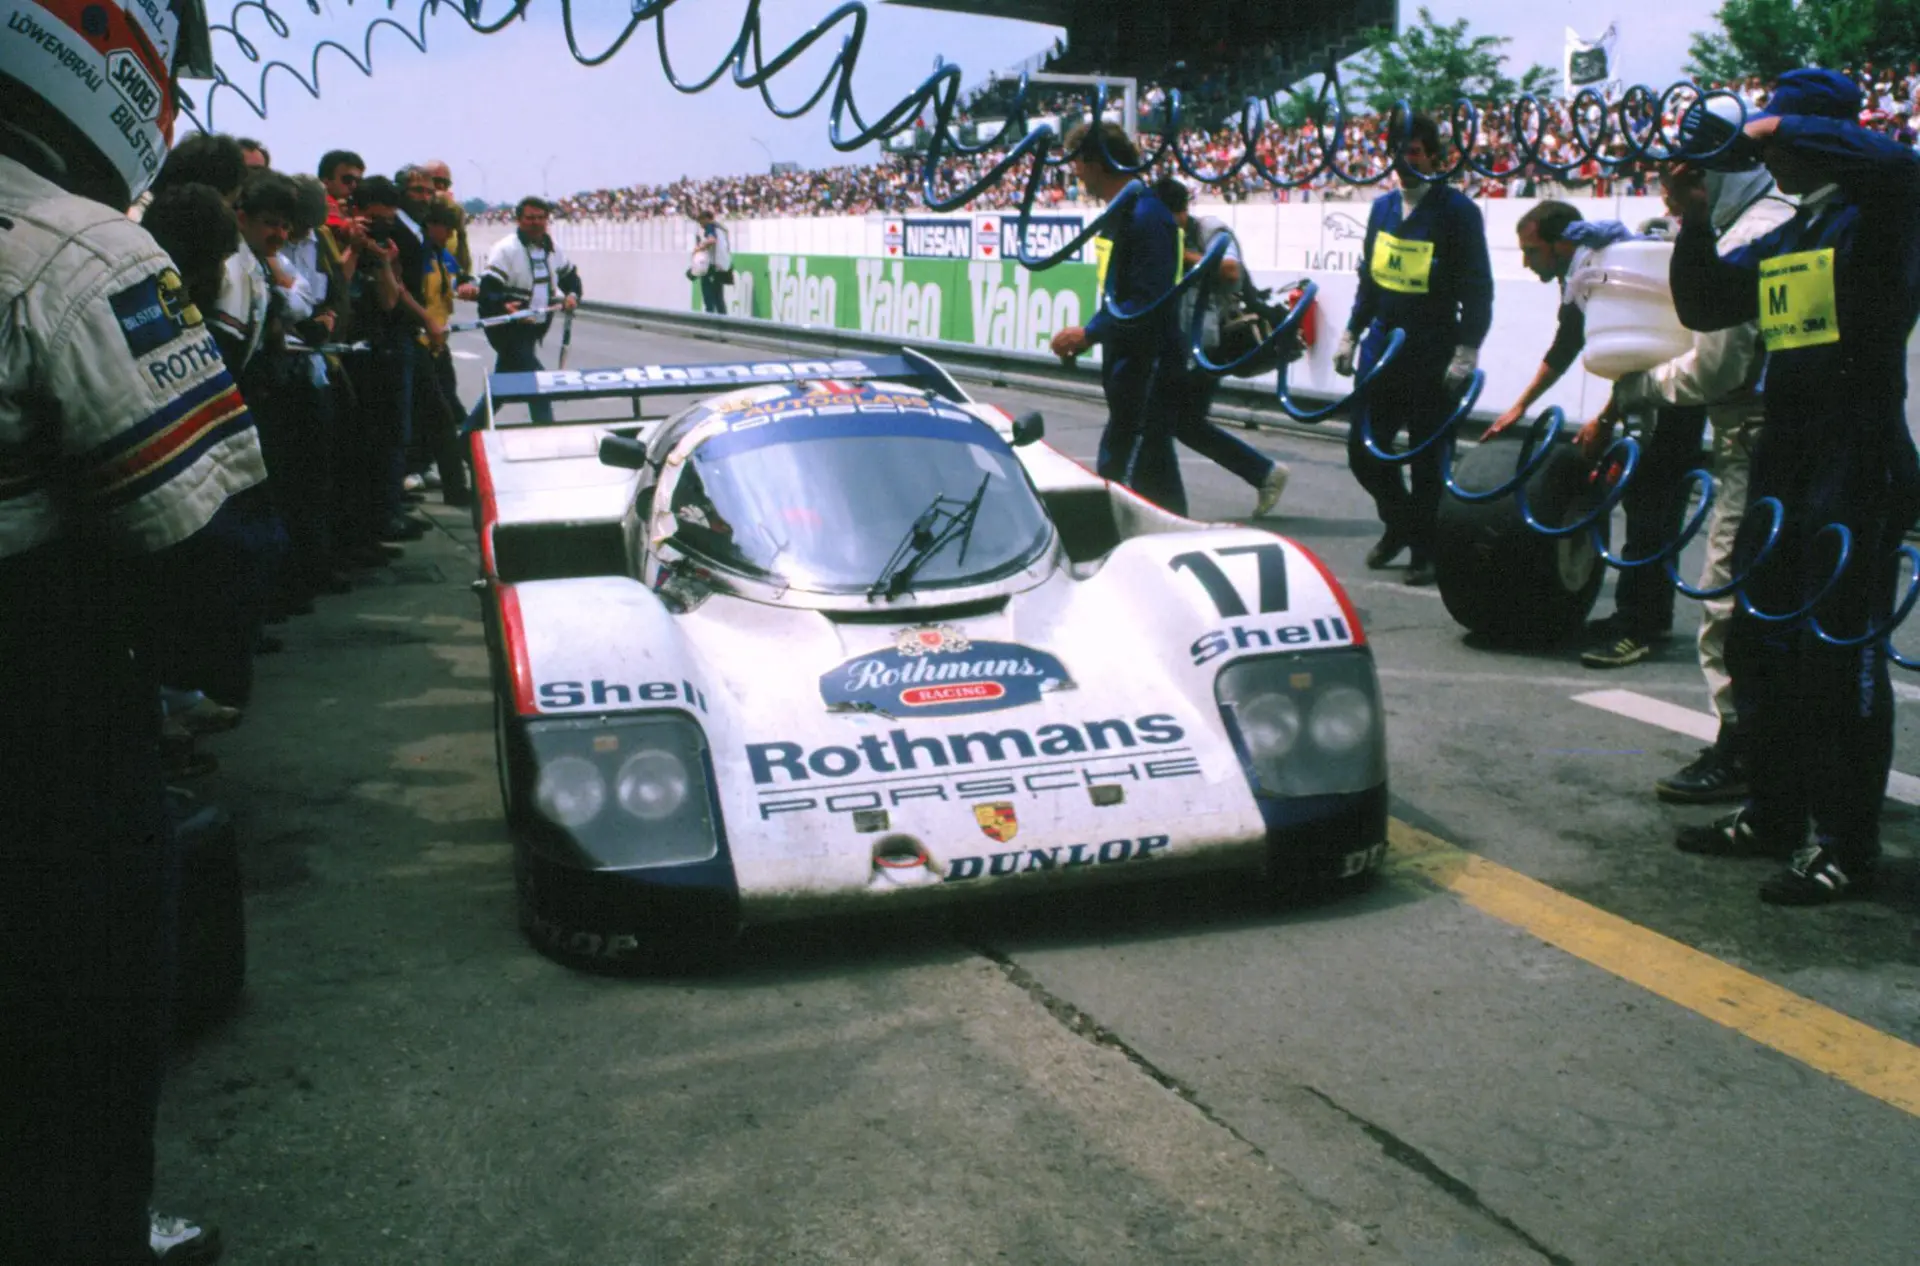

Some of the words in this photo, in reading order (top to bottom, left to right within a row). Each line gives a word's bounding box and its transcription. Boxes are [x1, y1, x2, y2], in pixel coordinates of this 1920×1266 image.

[8, 11, 104, 92] LÖWENBRÄU
[112, 58, 157, 117] SHOEI
[906, 224, 970, 258] NISSAN
[1003, 222, 1081, 259] NSSAN
[1389, 253, 1402, 272] M
[768, 255, 837, 328] Valeo
[856, 258, 942, 340] Valeo
[1768, 284, 1788, 316] M
[535, 360, 876, 393] Rothmans
[1168, 543, 1289, 619] 17
[1190, 616, 1352, 666] Shell
[539, 679, 708, 713] Shell
[844, 656, 1044, 692] Rothmans
[919, 686, 987, 701] RACING
[745, 713, 1185, 784] Rothmans
[758, 756, 1200, 820] PORSCHE
[943, 834, 1170, 882] DUNLOP
